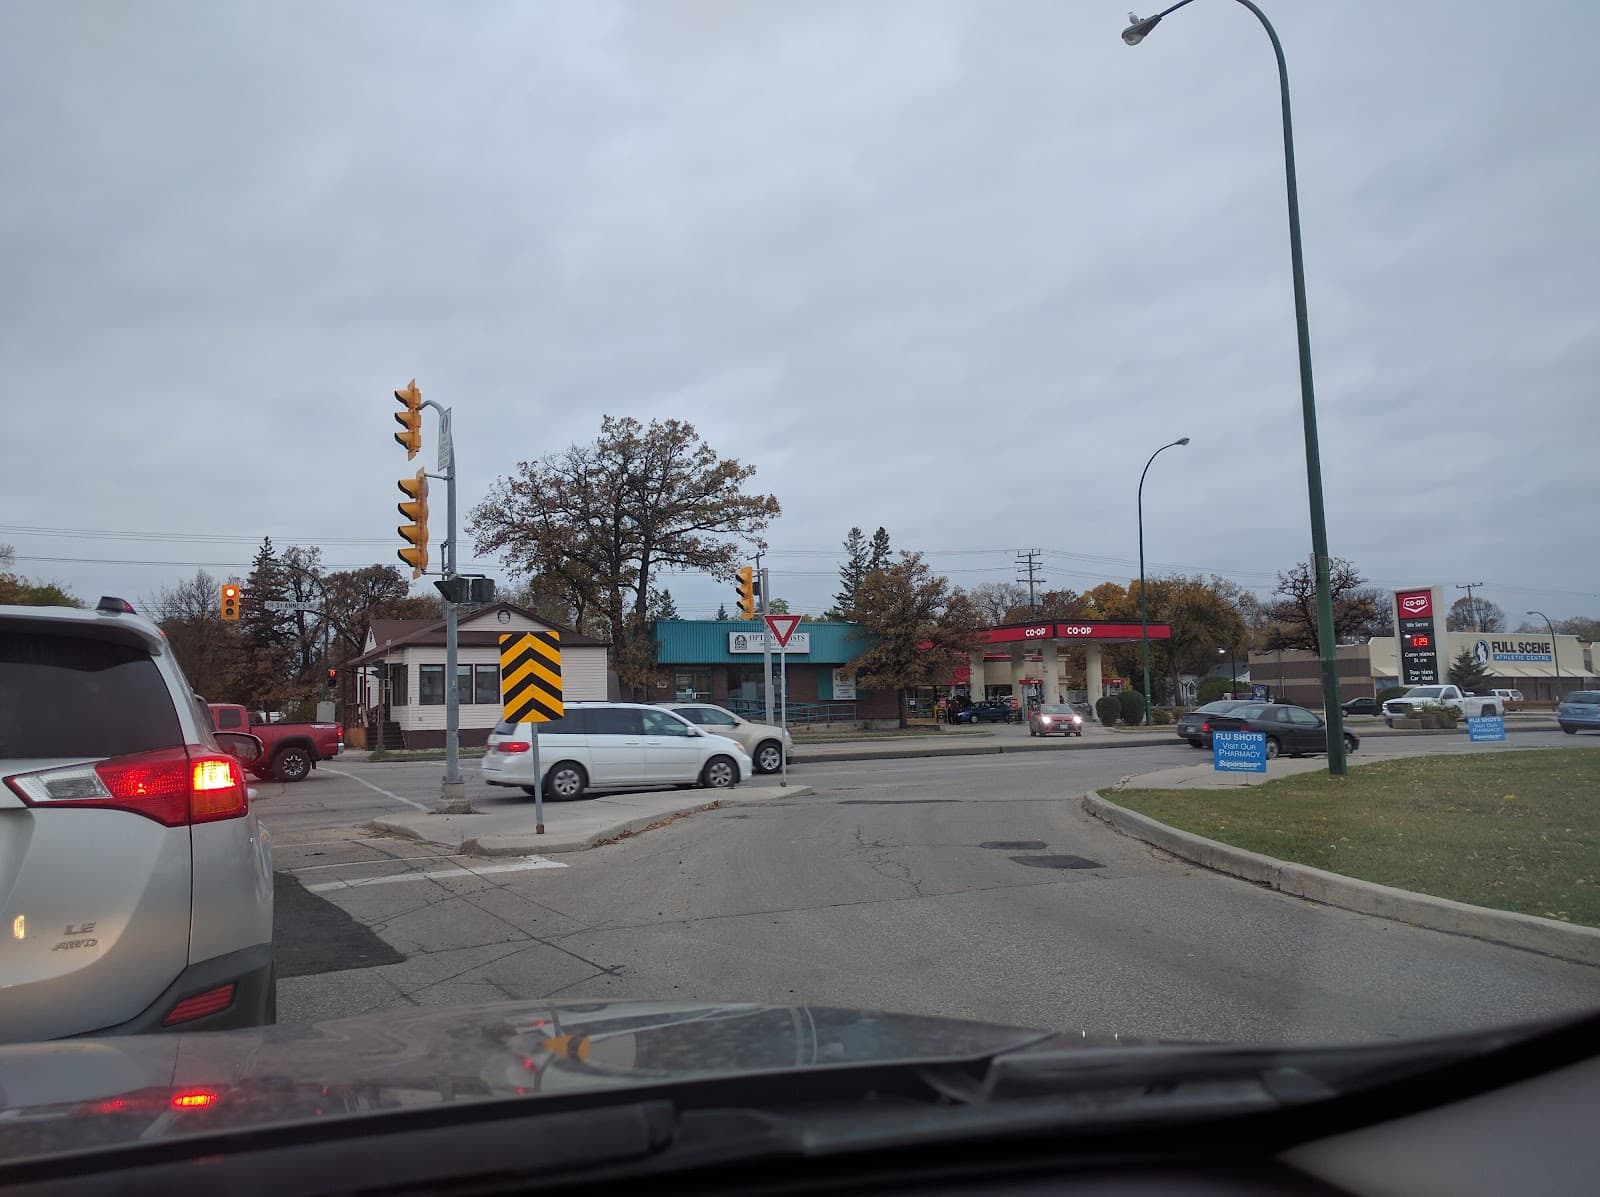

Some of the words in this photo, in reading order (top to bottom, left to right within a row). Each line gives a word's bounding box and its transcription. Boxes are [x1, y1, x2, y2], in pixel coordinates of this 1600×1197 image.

[1067, 627, 1092, 635] CO-OP
[1491, 641, 1516, 653] FULL
[1518, 642, 1551, 654] SCENE
[1233, 733, 1263, 741] SHOTS
[1218, 748, 1261, 758] PHARMACY
[64, 921, 96, 935] LE
[51, 939, 98, 951] AWD
